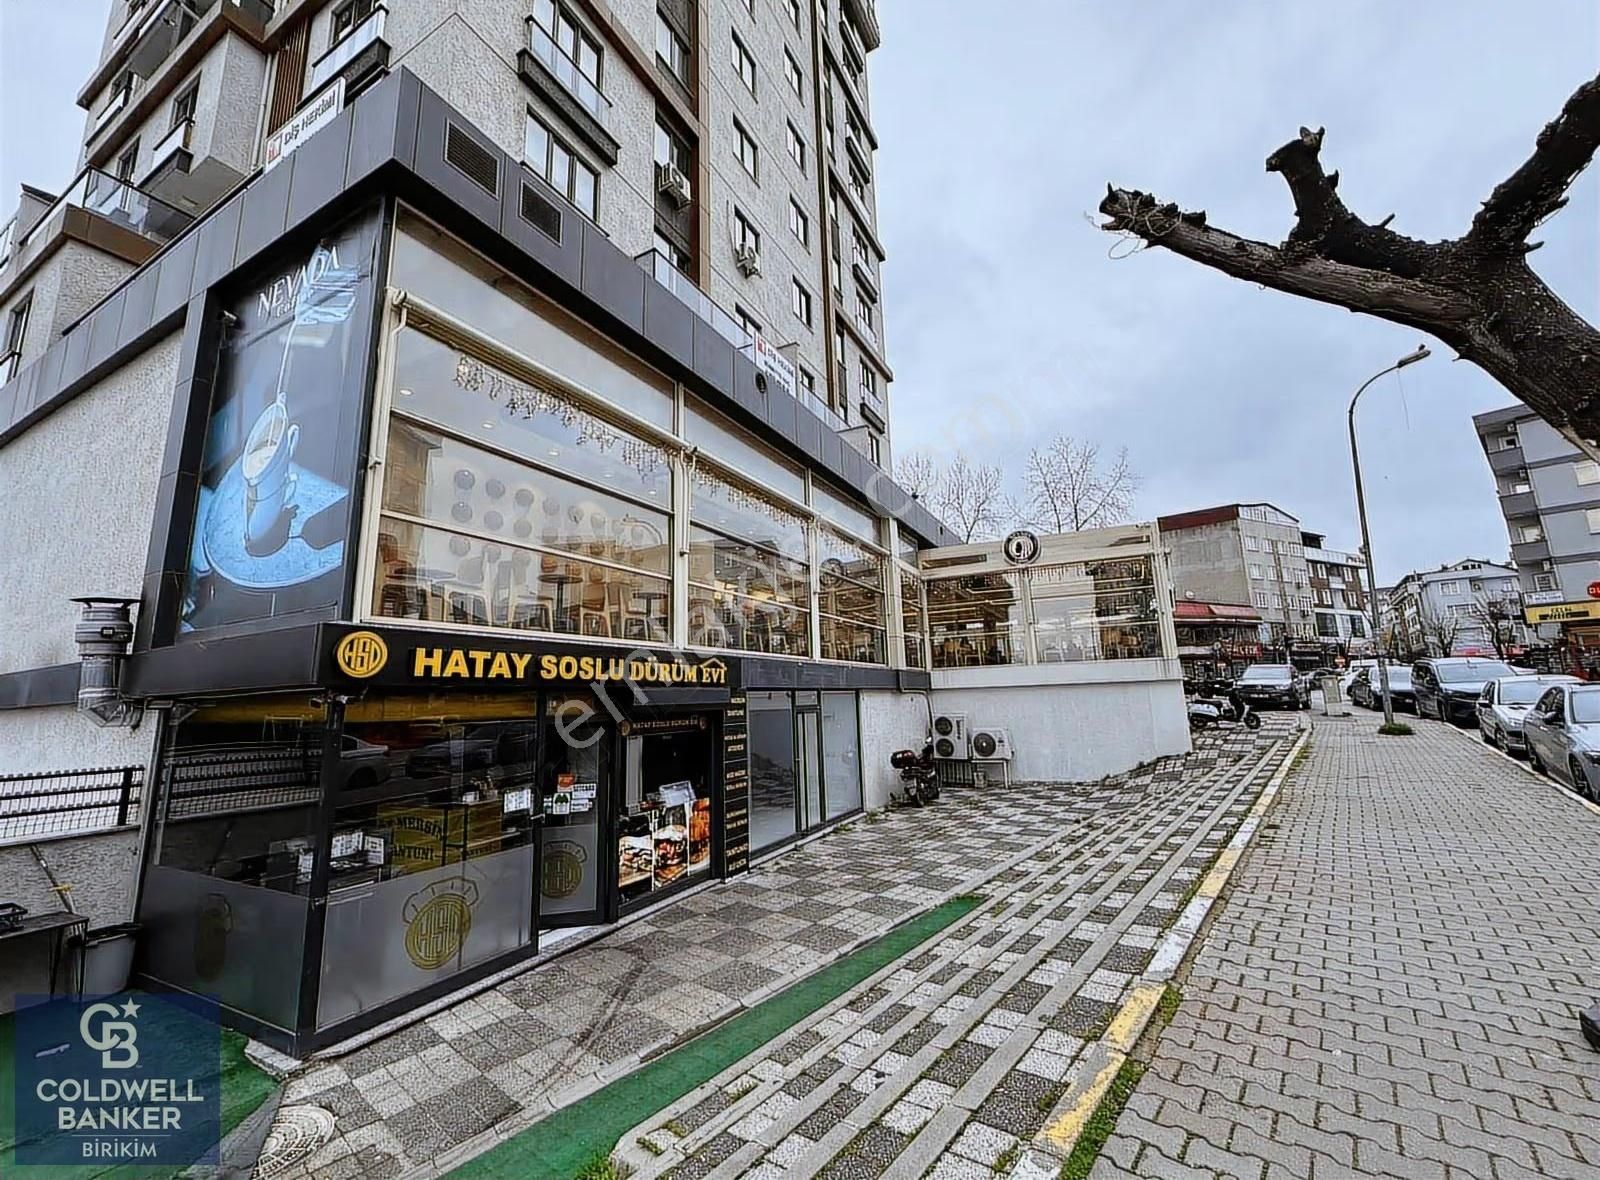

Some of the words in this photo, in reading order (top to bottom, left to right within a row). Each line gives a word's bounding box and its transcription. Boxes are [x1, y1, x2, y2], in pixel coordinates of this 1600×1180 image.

[414, 647, 532, 679] HATAY
[540, 654, 625, 680] SOSLU
[630, 656, 698, 683] DÜRÜM
